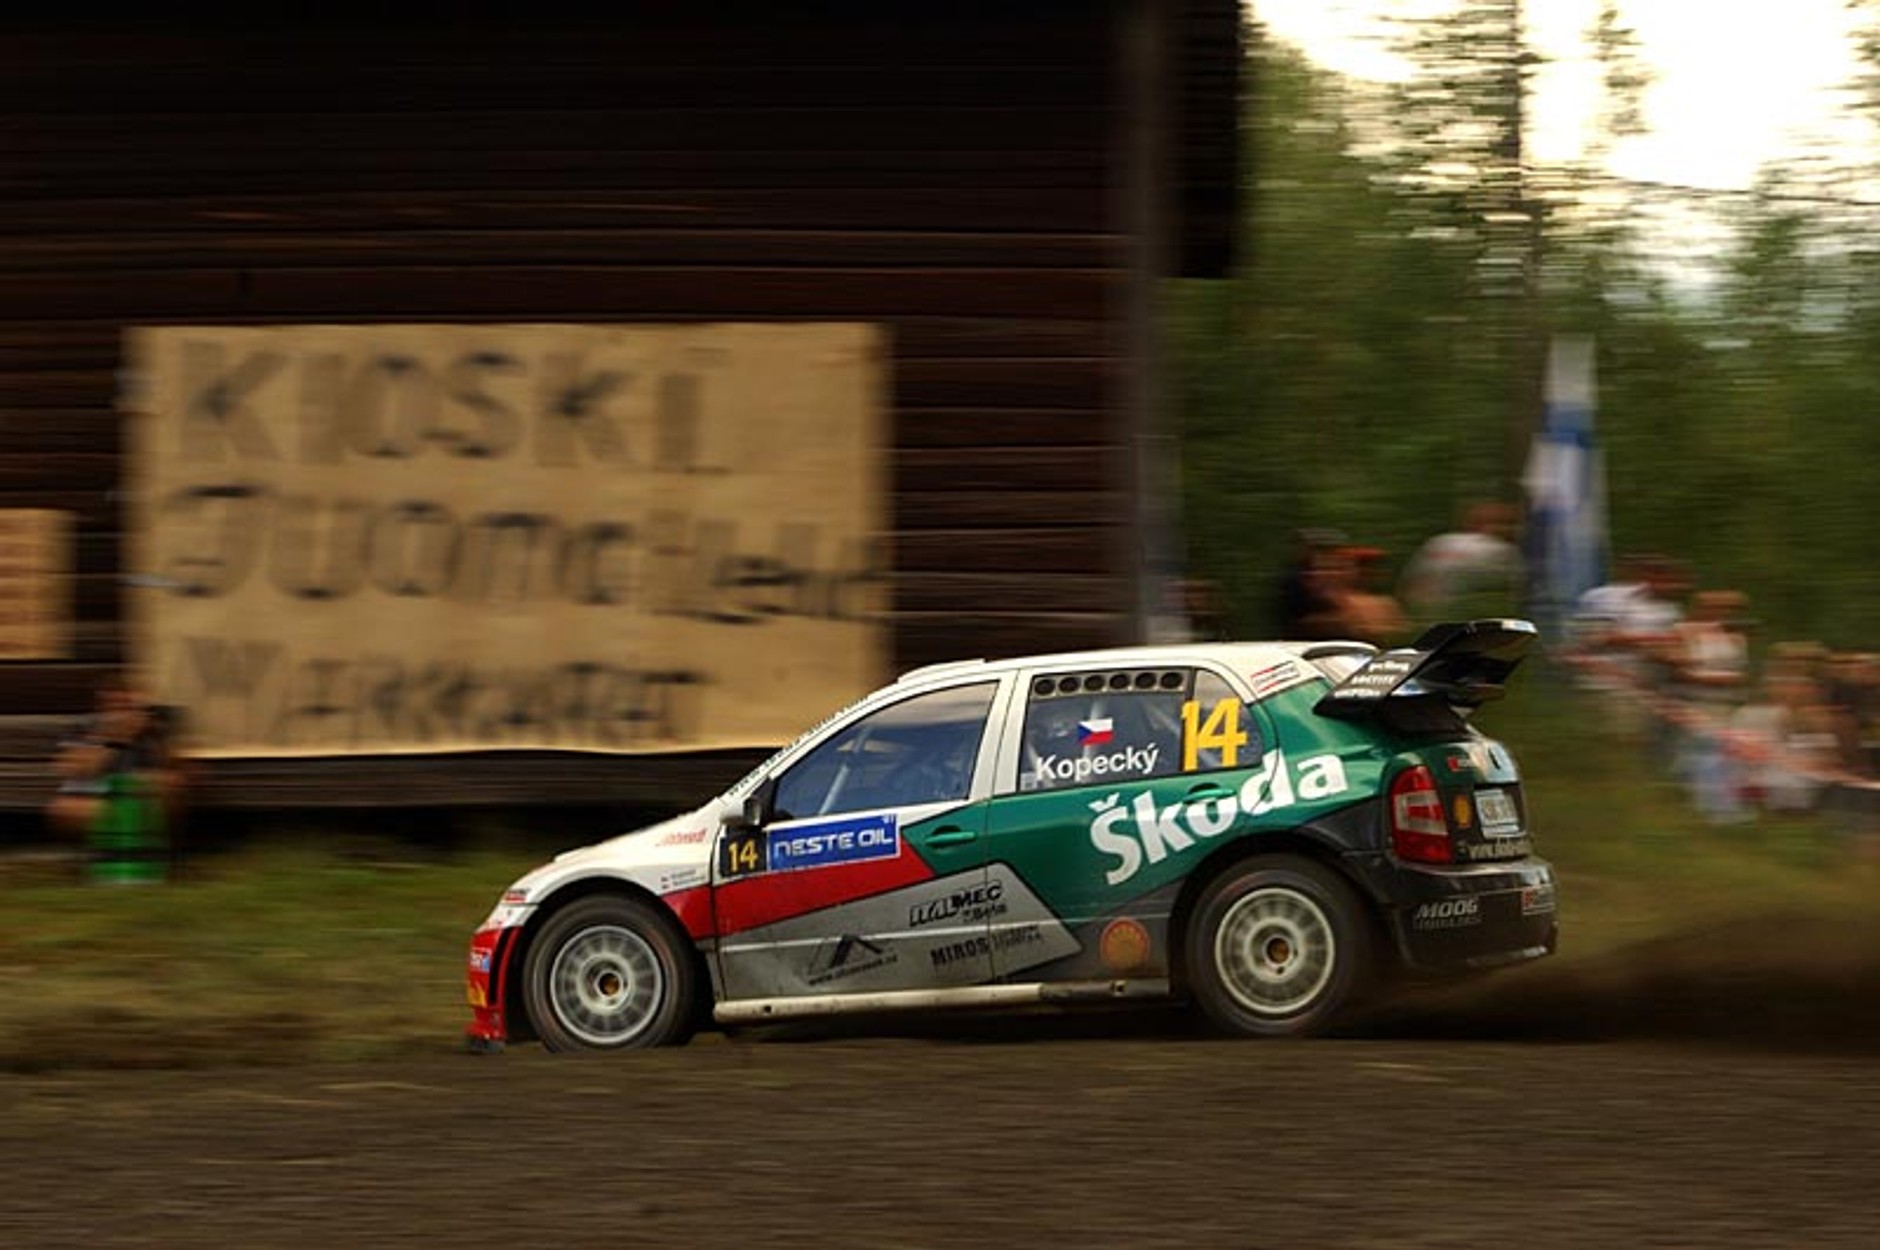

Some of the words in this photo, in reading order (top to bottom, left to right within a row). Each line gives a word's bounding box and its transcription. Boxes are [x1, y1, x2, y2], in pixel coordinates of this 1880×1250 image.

[176, 342, 706, 472] KIOSKI
[1180, 697, 1248, 772] 14
[1036, 742, 1160, 782] Kopecký
[1089, 748, 1348, 886] Škoda
[728, 838, 759, 873] 14
[858, 827, 894, 848] OIL
[1416, 898, 1478, 919] MOOG
[930, 937, 990, 966] MIROS
